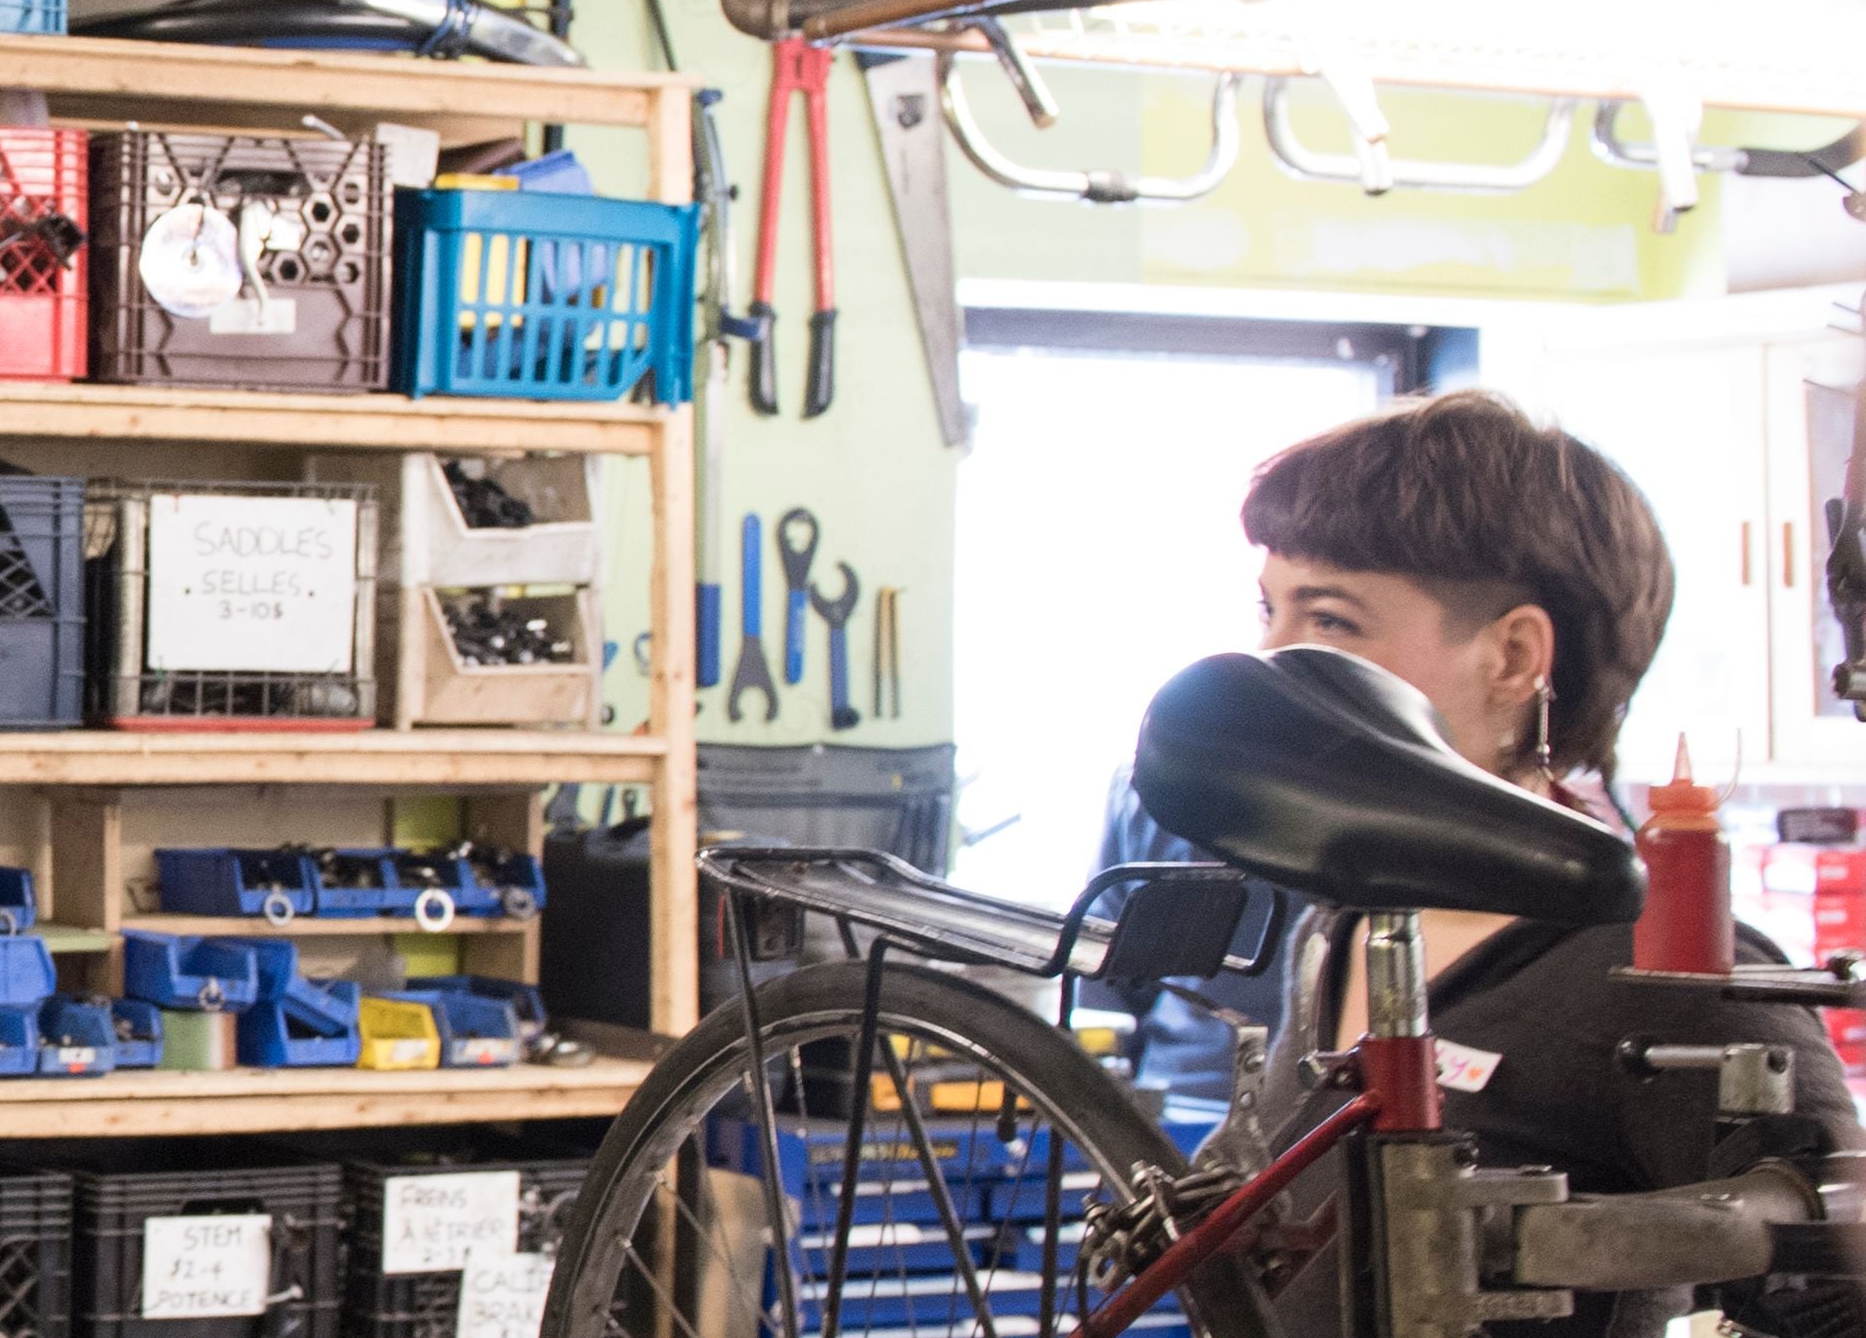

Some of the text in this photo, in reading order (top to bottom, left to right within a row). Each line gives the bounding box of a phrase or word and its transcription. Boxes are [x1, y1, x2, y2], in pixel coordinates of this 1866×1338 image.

[194, 521, 333, 560] SADDLES
[201, 570, 301, 597] SELLES
[184, 1224, 242, 1251] STEM
[158, 1289, 252, 1310] POTENCE
